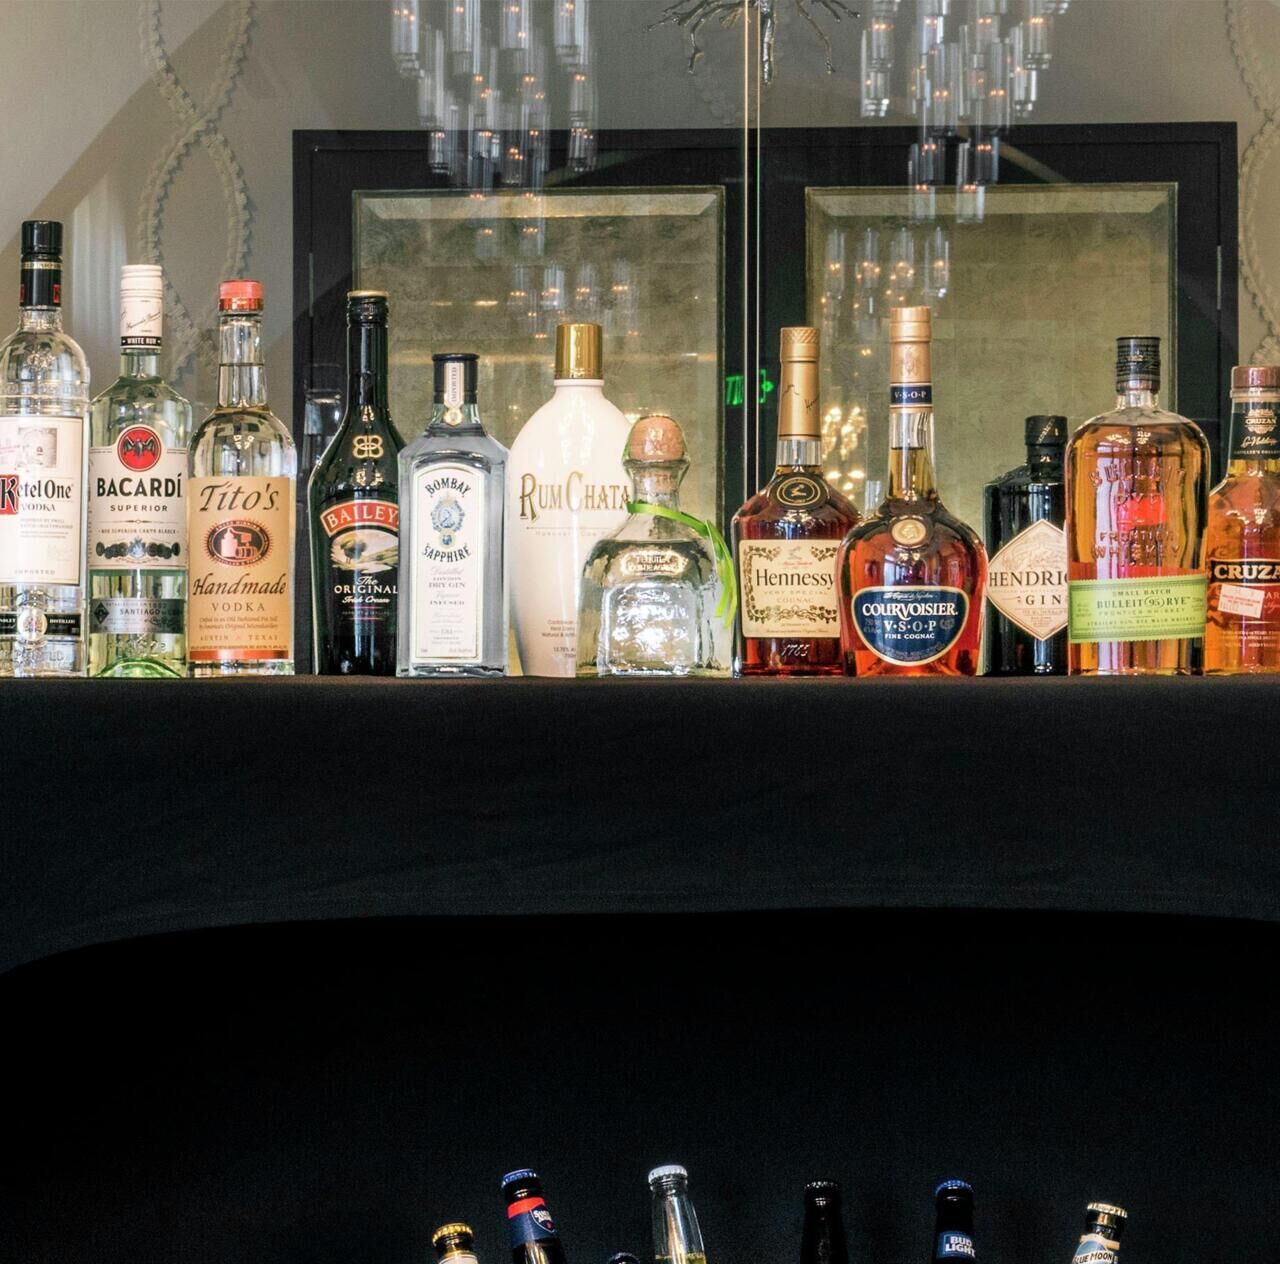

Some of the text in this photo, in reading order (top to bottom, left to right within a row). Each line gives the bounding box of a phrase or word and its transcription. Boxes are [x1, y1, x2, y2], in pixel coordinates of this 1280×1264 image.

[44, 479, 72, 499] One
[424, 477, 472, 496] BOMBAY
[20, 503, 56, 512] VODKA
[110, 504, 168, 512] SUPERIOR
[422, 543, 472, 563] SAPPHIRE
[192, 572, 288, 596] Handmade
[755, 568, 835, 591] Hennessy
[333, 584, 399, 594] ORIGINAL
[1143, 588, 1172, 596] BATCH
[1025, 594, 1062, 606] GIN
[1096, 596, 1185, 609] BULLEIT RYE
[120, 608, 160, 616] SANTIAGO
[211, 602, 266, 612] VODKA
[949, 1235, 973, 1248] BUD
[945, 1243, 976, 1258] LIGHT
[1090, 1251, 1113, 1262] MOON
